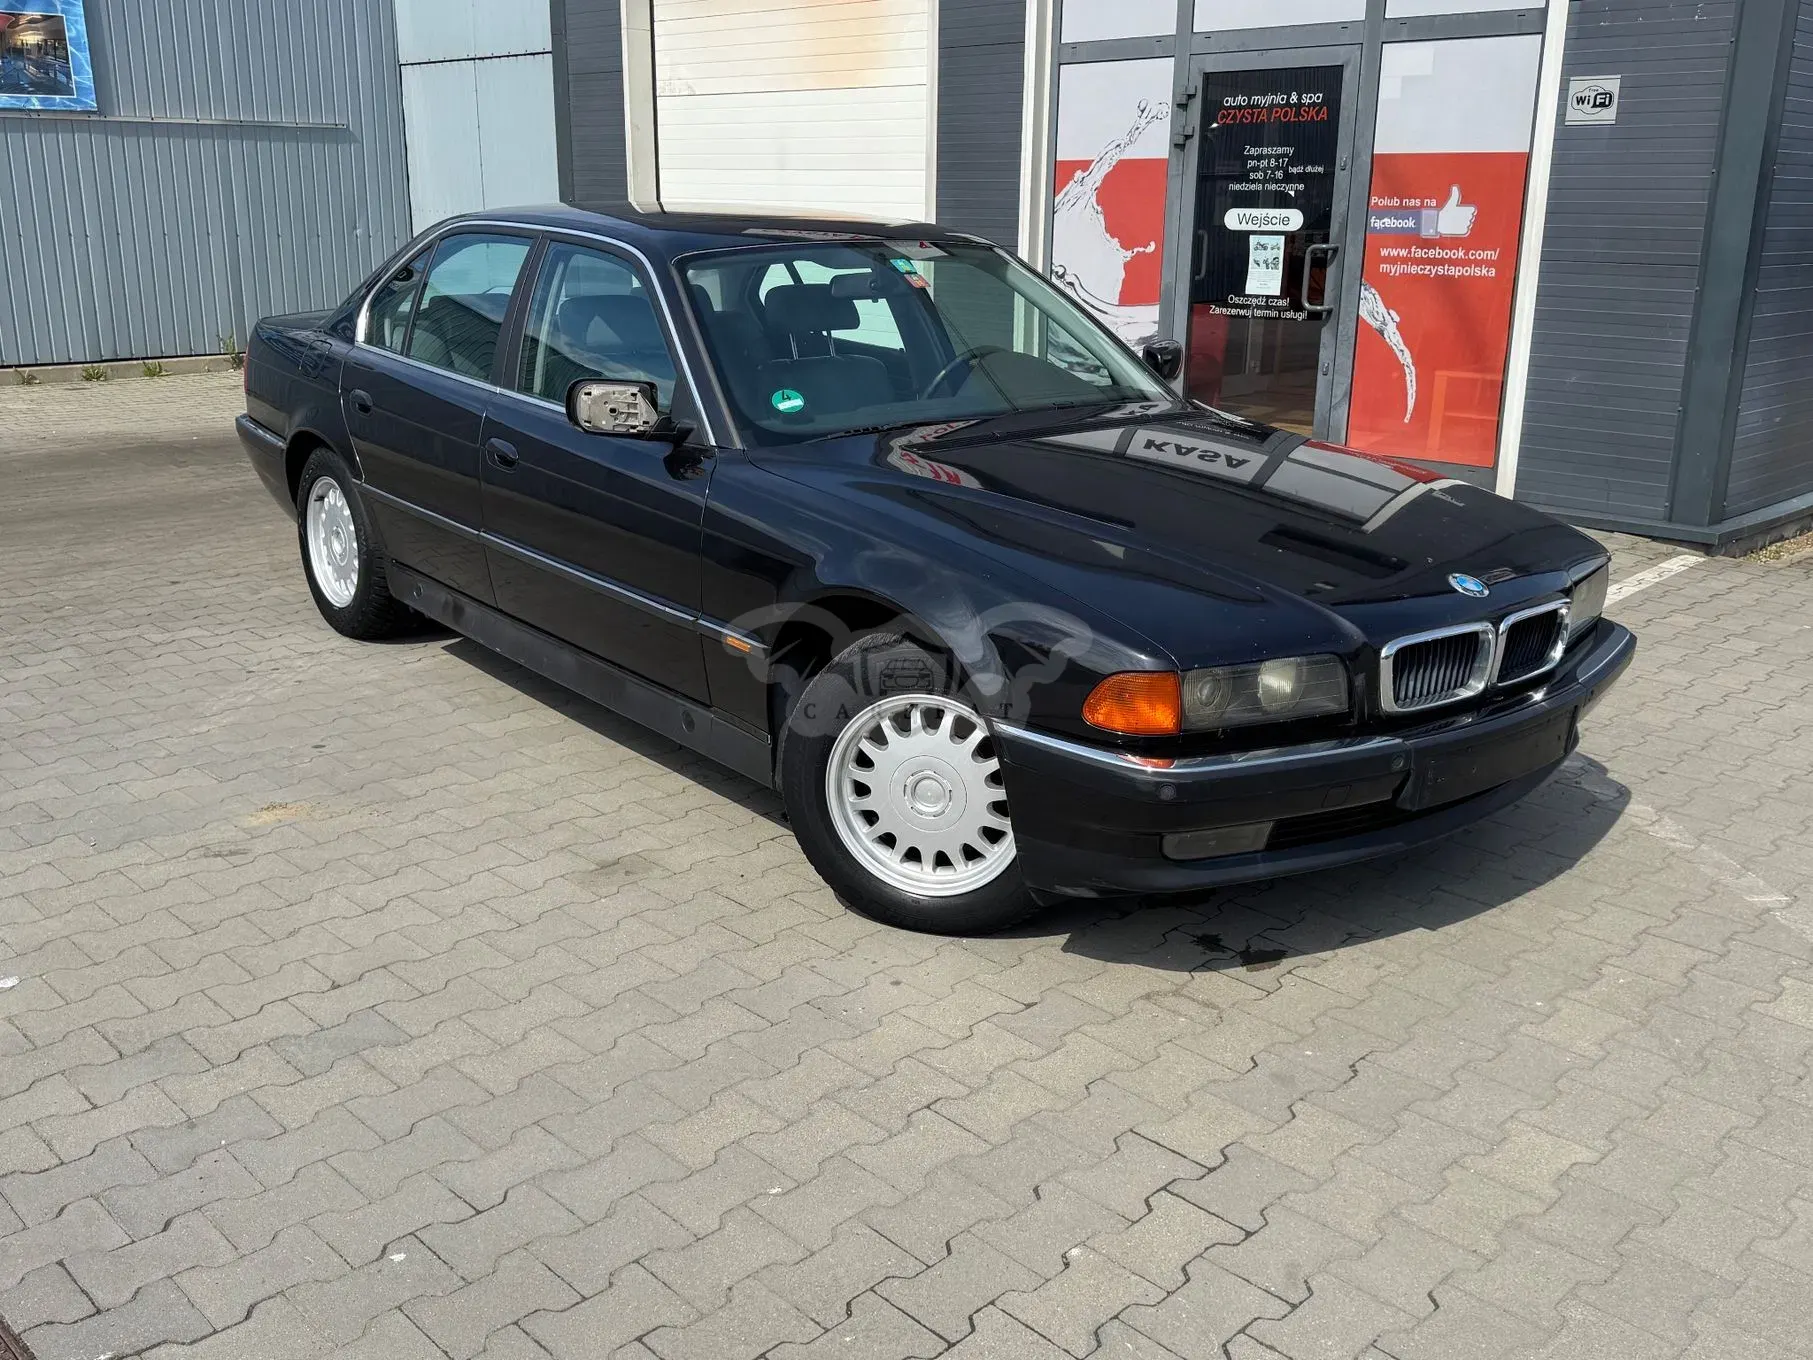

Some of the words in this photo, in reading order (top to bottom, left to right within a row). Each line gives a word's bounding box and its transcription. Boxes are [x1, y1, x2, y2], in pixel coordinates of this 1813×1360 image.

[1223, 94, 1248, 106] auto
[1250, 92, 1287, 107] myjnia
[1289, 91, 1299, 104] &
[1300, 92, 1323, 105] spa
[1217, 108, 1267, 124] CZYSTA
[1270, 106, 1328, 122] POLSKA
[1243, 145, 1295, 156] Zapraszamy
[1247, 158, 1268, 169] pn-pt
[1269, 158, 1288, 168] 8-17
[1249, 171, 1264, 180] sob
[1266, 170, 1284, 180] 7-16
[1228, 182, 1263, 191] niedziela
[1264, 182, 1305, 193] nieczynne
[1371, 196, 1400, 206] Polub
[1402, 198, 1421, 206] nas
[1423, 198, 1437, 207] na
[1237, 213, 1290, 228] Wejście
[1379, 245, 1500, 261] www.facebook.com/
[1379, 262, 1496, 278] myjnieczystapolska
[1227, 294, 1267, 307] Oszczędź
[1267, 297, 1290, 307] czas!
[1209, 305, 1252, 318] Zarezerwuj
[1253, 308, 1279, 318] termin
